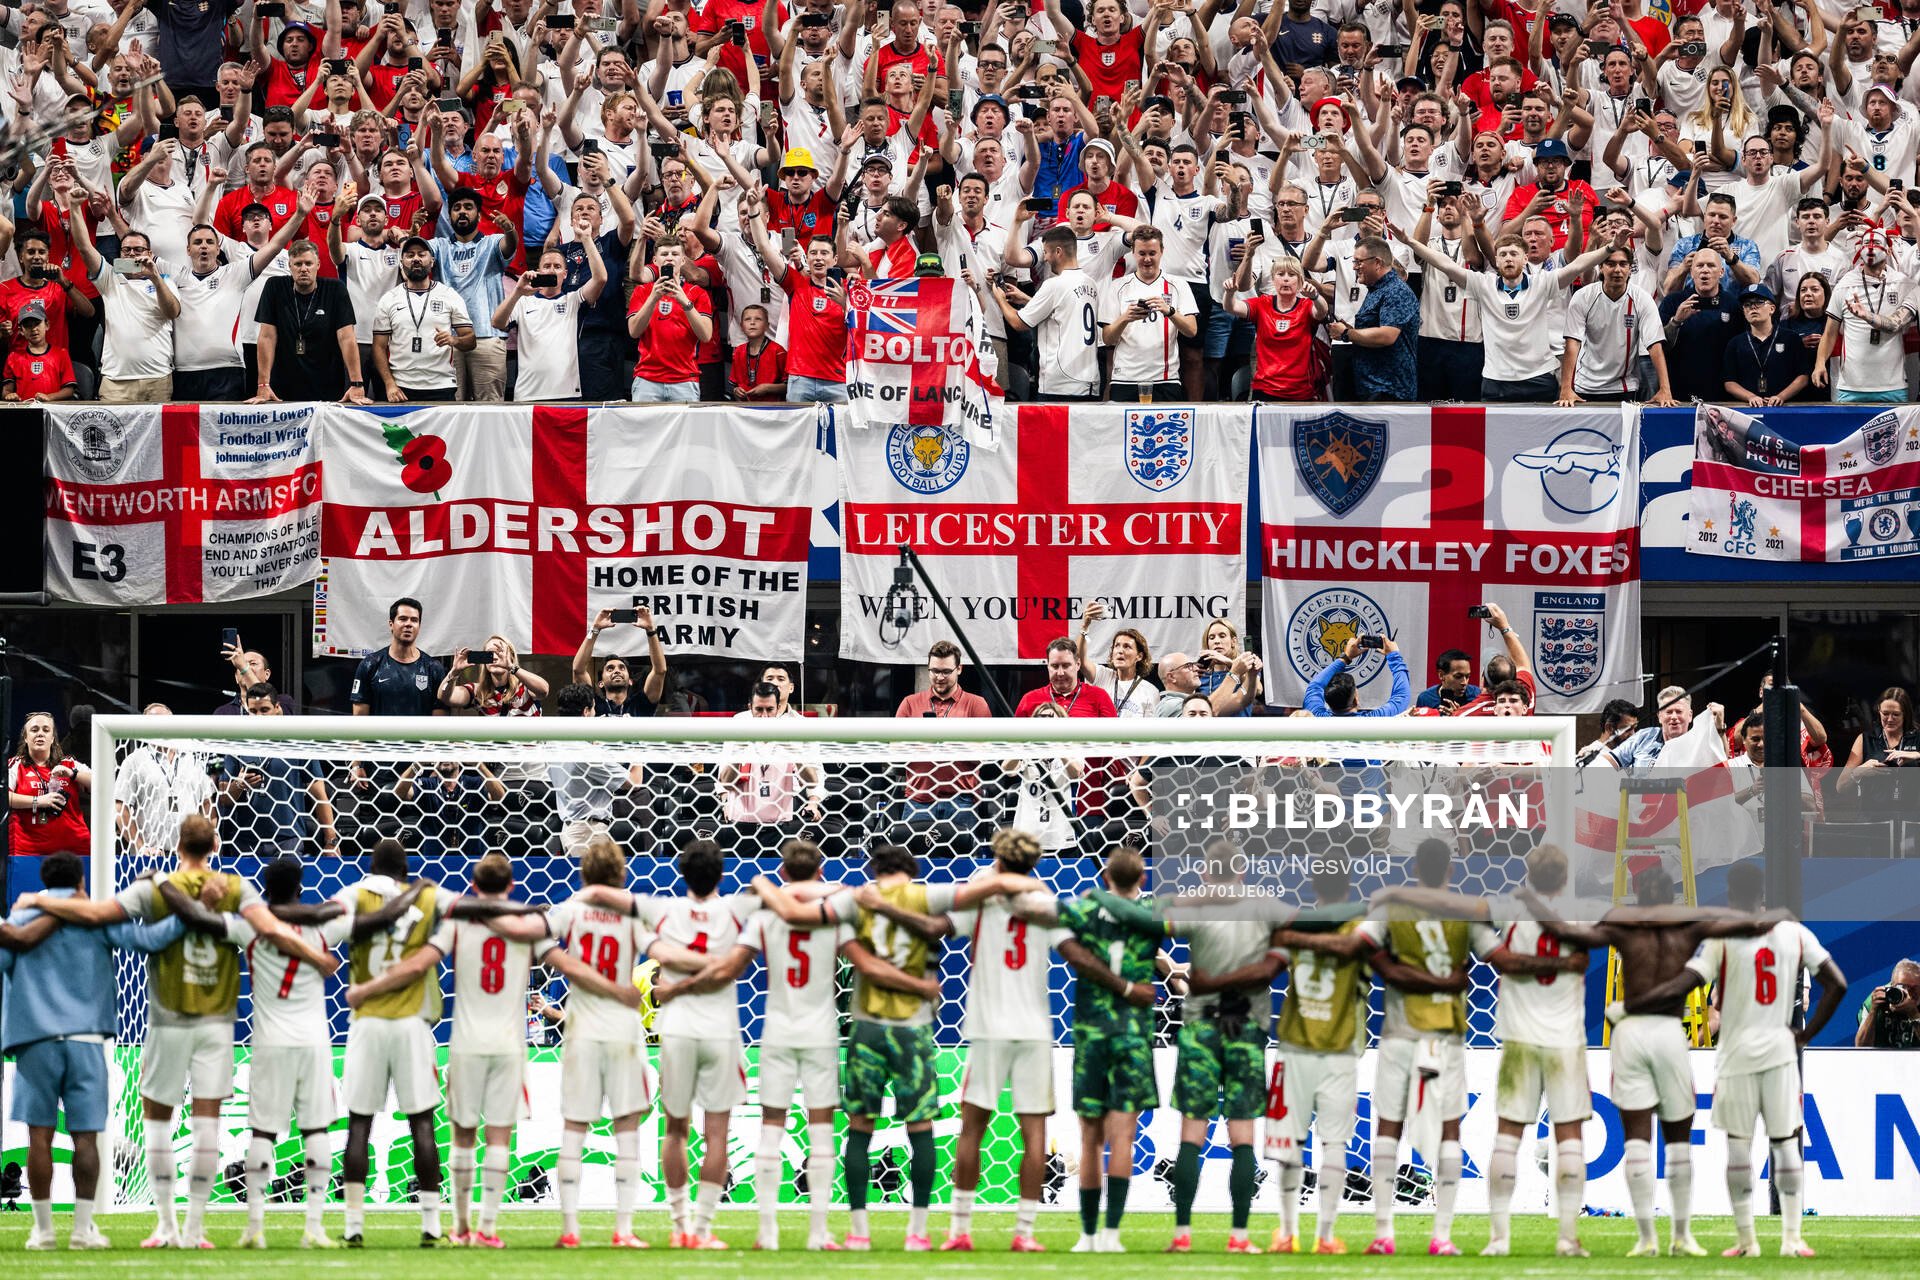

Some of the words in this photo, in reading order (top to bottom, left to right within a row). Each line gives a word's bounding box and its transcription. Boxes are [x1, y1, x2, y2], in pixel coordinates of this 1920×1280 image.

[1173, 213, 1183, 232] 4
[453, 247, 476, 261] NIKE
[881, 296, 898, 308] 77
[1073, 285, 1098, 300] FOWLER
[1083, 303, 1095, 346] 9
[880, 385, 908, 401] OF
[68, 411, 106, 437] WENTWORTH
[218, 411, 268, 425] Johnnie
[272, 406, 316, 423] Lowery
[220, 431, 271, 446] Football
[71, 455, 105, 478] FOOTBALL
[105, 459, 121, 476] CLUB
[891, 453, 943, 490] FOOTBALL
[945, 453, 966, 483] CLUB
[1299, 433, 1318, 486] LEICESTER
[1320, 488, 1337, 505] CITY
[1342, 464, 1376, 506] FOOTBALL
[1372, 435, 1382, 459] CLUB
[1839, 459, 1858, 470] 1966
[1754, 475, 1873, 498] CHELSEA
[1877, 494, 1890, 503] THE
[1894, 490, 1911, 501] ONLY
[47, 486, 207, 516] WENTWORTH
[209, 529, 278, 544] CHAMPIONS
[280, 524, 294, 537] OF
[297, 515, 317, 531] MILE
[355, 503, 775, 557] ALDERSHOT
[855, 512, 1111, 546] LEICESTER
[1123, 511, 1229, 545] CITY
[1699, 531, 1718, 543] 2012
[205, 550, 230, 560] END
[233, 549, 257, 560] AND
[1724, 540, 1756, 555] CFC
[1765, 538, 1784, 550] 2021
[1853, 547, 1873, 558] TEAM
[1877, 545, 1886, 555] IN
[1890, 542, 1919, 554] LONDON
[72, 541, 126, 583] E3
[211, 566, 253, 577] YOU'LL
[255, 557, 291, 575] NEVER
[293, 547, 318, 565] SING
[1272, 538, 1491, 572] HINCKLEY
[1505, 542, 1630, 576] FOXES
[254, 575, 282, 590] THAT
[594, 565, 684, 588] HOME
[691, 565, 731, 587] OF
[738, 568, 799, 592] THE
[960, 596, 1083, 621] YOU'RE
[1542, 595, 1600, 606] ENGLAND
[1294, 594, 1359, 633] LEICESTER
[1362, 605, 1385, 636] CITY
[656, 624, 739, 648] ARMY
[1004, 916, 1026, 971] 3
[278, 924, 302, 999] 7
[480, 935, 507, 994] 8
[579, 932, 619, 984] 18
[787, 930, 811, 989] 5
[1754, 947, 1776, 1005] 6
